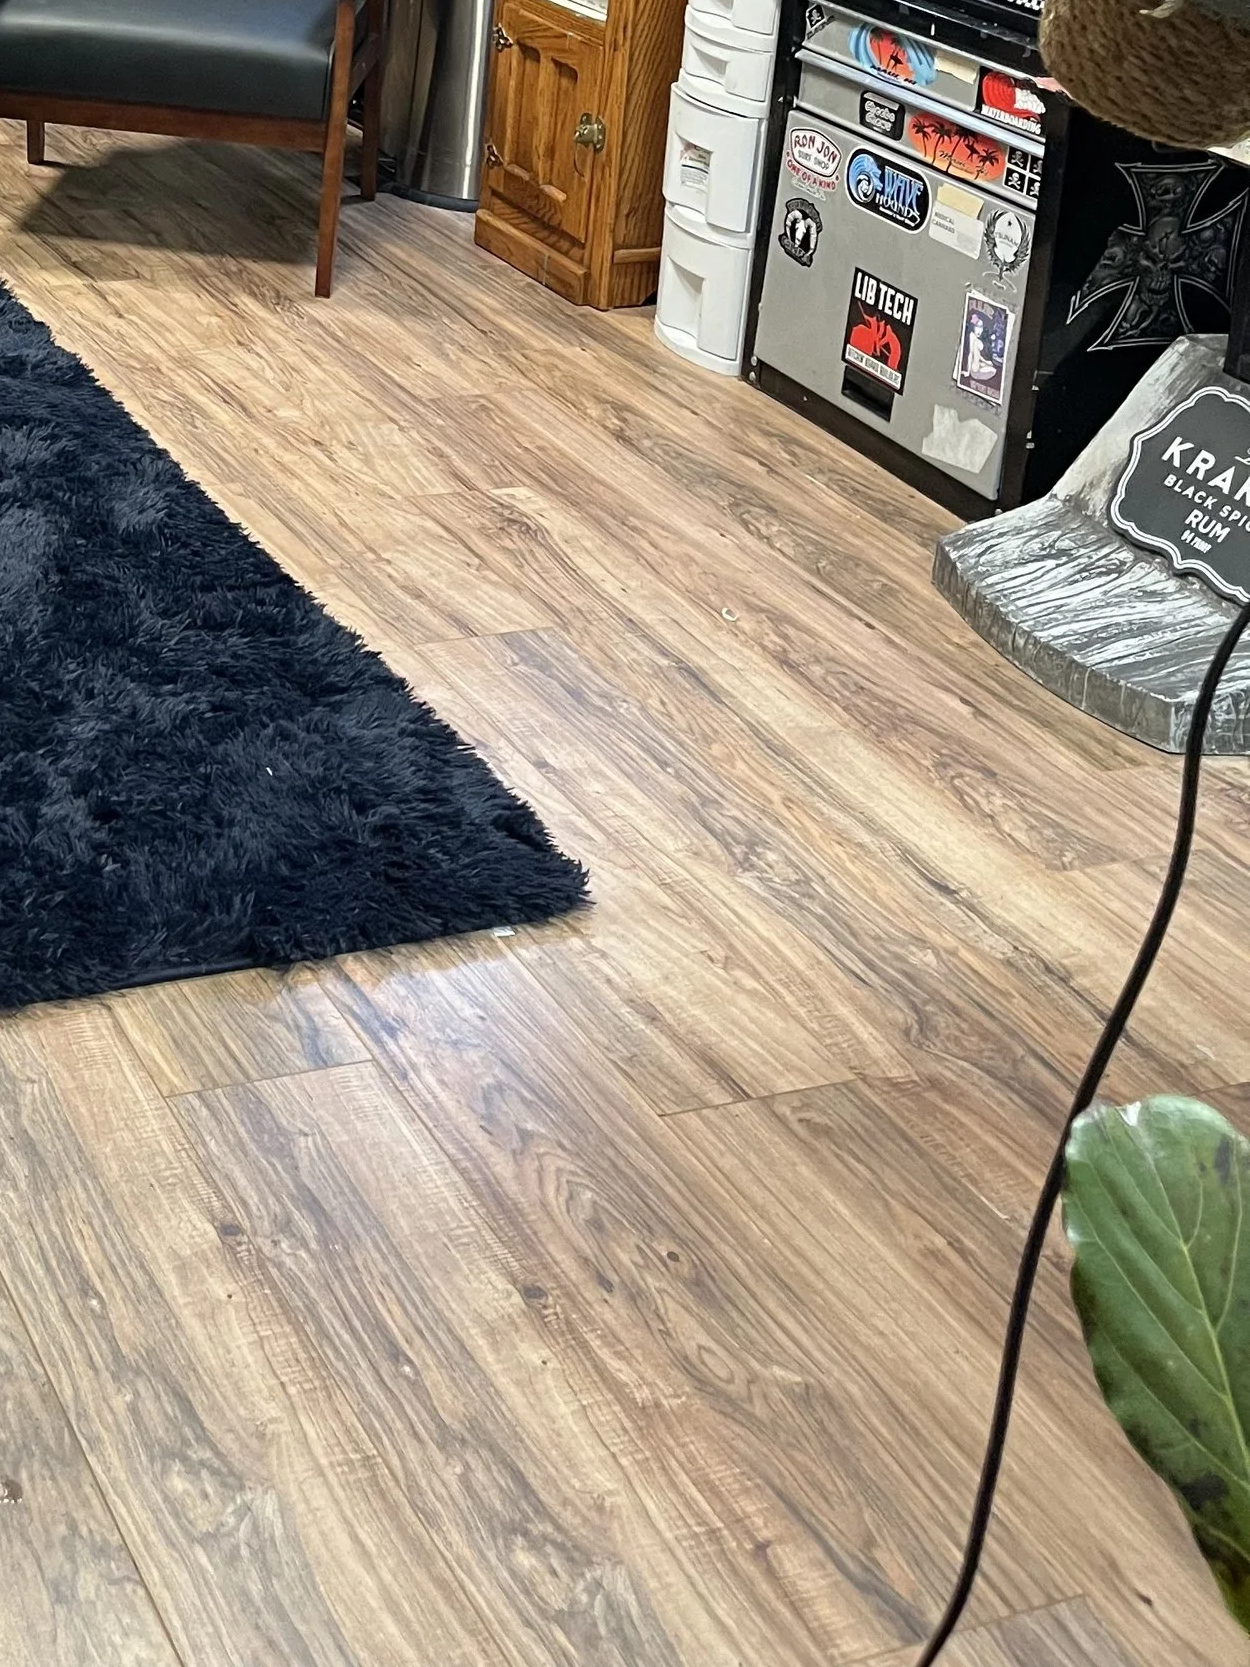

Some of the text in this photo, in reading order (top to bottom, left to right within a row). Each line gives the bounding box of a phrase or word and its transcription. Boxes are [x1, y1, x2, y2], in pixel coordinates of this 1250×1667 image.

[794, 134, 838, 164] RON JON
[787, 159, 801, 176] ONE
[801, 171, 811, 182] OF
[818, 178, 836, 191] KIND
[884, 165, 924, 216] WAVE
[854, 271, 915, 326] LIB TECH
[1163, 473, 1218, 510] BLACK
[1184, 508, 1231, 543] RUM
